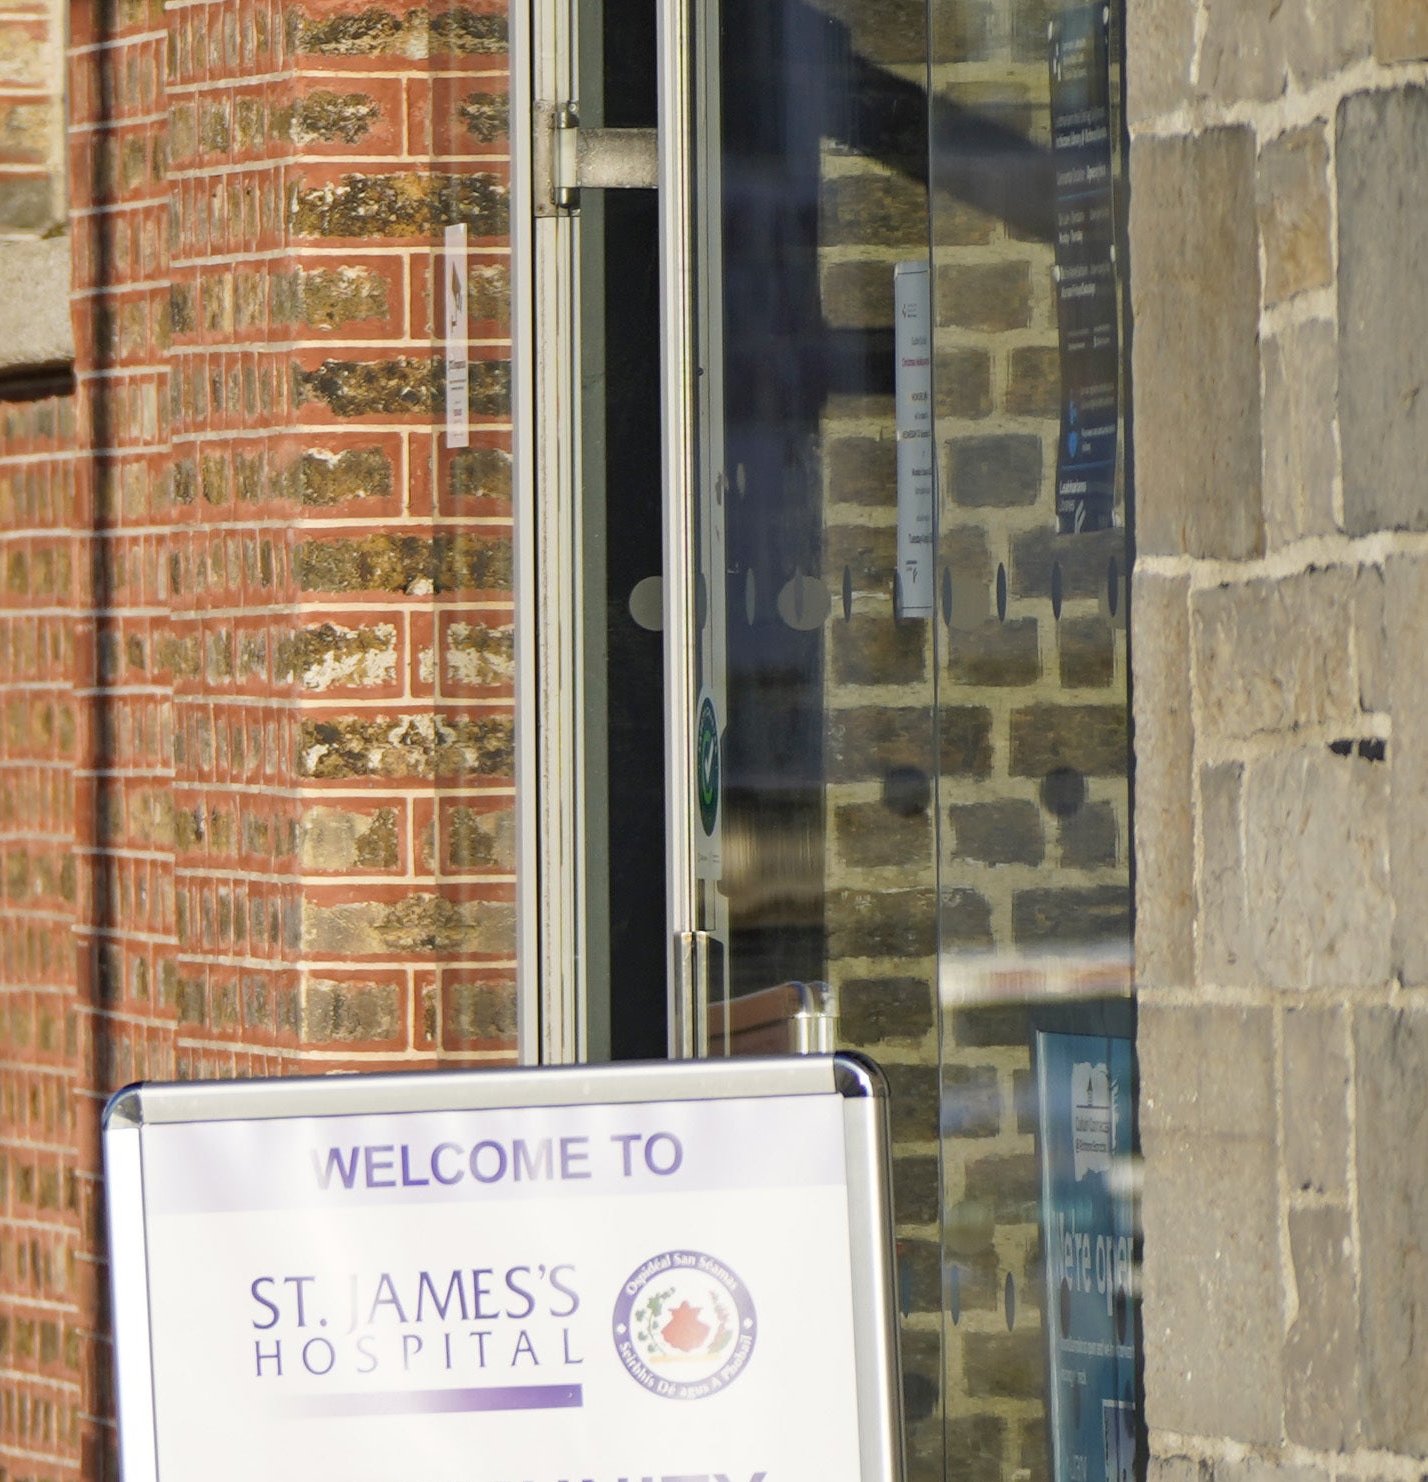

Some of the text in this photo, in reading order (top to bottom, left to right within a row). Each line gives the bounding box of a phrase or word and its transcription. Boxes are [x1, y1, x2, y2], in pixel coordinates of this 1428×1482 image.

[310, 1130, 684, 1190] WELCOME TO
[674, 1253, 696, 1266] San
[250, 1263, 581, 1335] ST. JAMES'S
[254, 1327, 584, 1378] HOSPITAL
